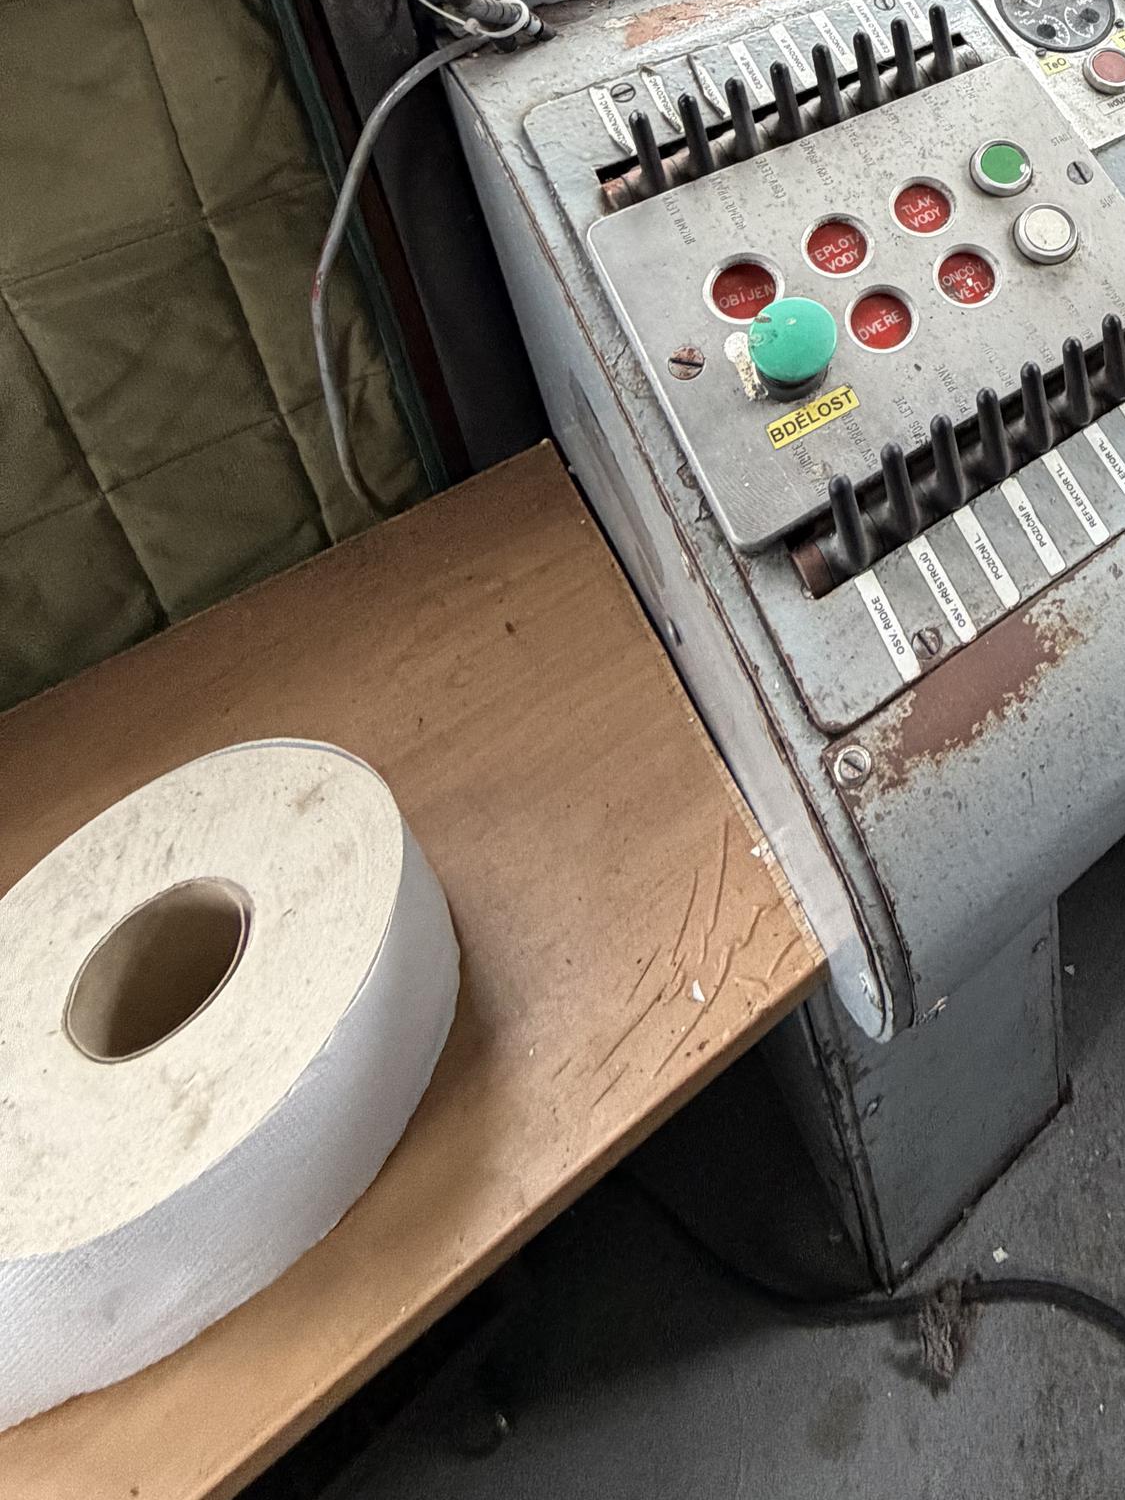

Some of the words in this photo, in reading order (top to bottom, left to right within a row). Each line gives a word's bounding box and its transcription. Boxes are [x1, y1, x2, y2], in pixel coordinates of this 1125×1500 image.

[1044, 57, 1067, 72] TeO
[902, 195, 935, 215] TLAK
[909, 207, 941, 228] VODY
[825, 249, 860, 271] VODY
[858, 309, 903, 341] DVEŘE
[769, 388, 855, 445] BDĚLOST
[1095, 436, 1110, 451] PL.
[1052, 462, 1068, 479] TL.
[1061, 476, 1098, 529] REFLEKTOR
[1019, 511, 1049, 550] POZIČNÍ
[974, 542, 1004, 582] POZIČNÍ
[916, 551, 956, 607] PŘÍSTROJŮ
[868, 595, 895, 633] ŘIDIČE
[948, 604, 969, 629] OSV.
[887, 628, 908, 656] OSV.
